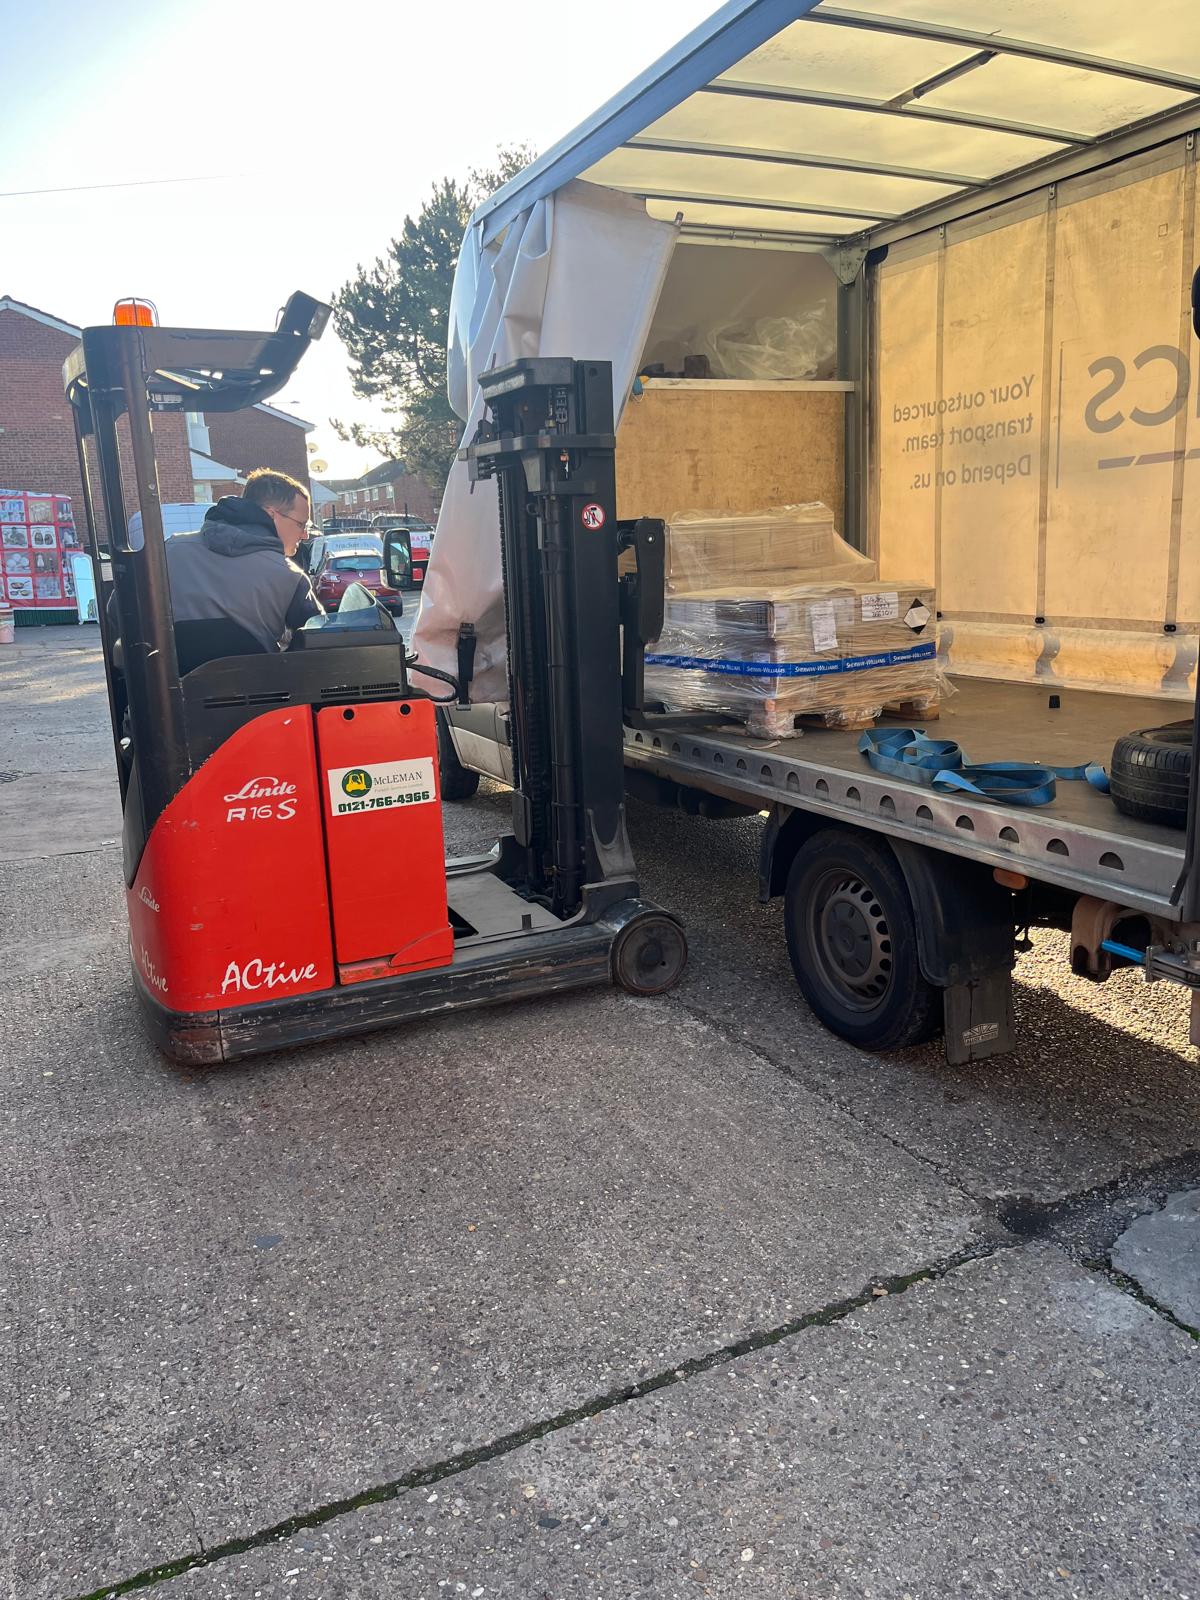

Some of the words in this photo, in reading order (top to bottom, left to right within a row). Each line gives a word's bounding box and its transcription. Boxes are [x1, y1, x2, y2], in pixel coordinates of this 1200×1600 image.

[223, 776, 297, 802] Linde
[374, 770, 423, 786] McLEMAN
[338, 791, 430, 813] 0121-766-4966
[138, 886, 160, 913] Linde
[221, 958, 318, 995] ACtive
